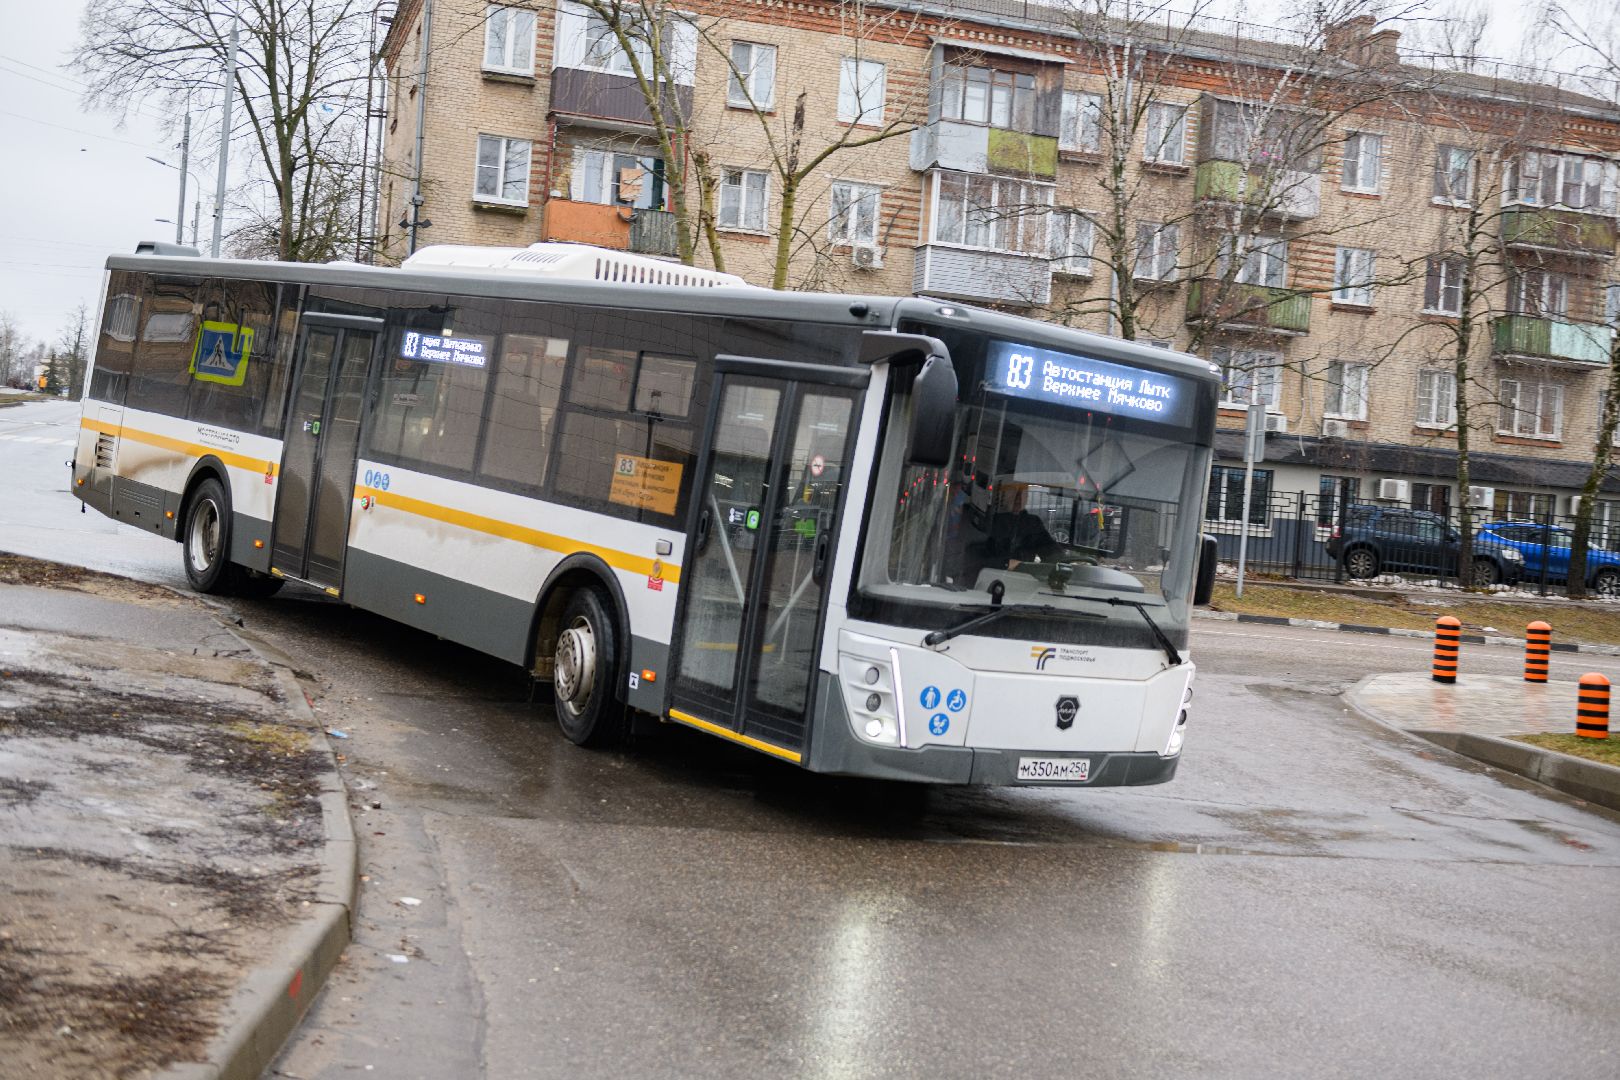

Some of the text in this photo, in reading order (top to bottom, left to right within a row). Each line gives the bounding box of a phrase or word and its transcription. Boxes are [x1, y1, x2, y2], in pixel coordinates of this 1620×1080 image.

[1007, 353, 1033, 389] 83
[1043, 360, 1171, 399] Автостанция Лытк
[1043, 378, 1163, 412] Верхнее Мячково
[620, 459, 633, 473] 83
